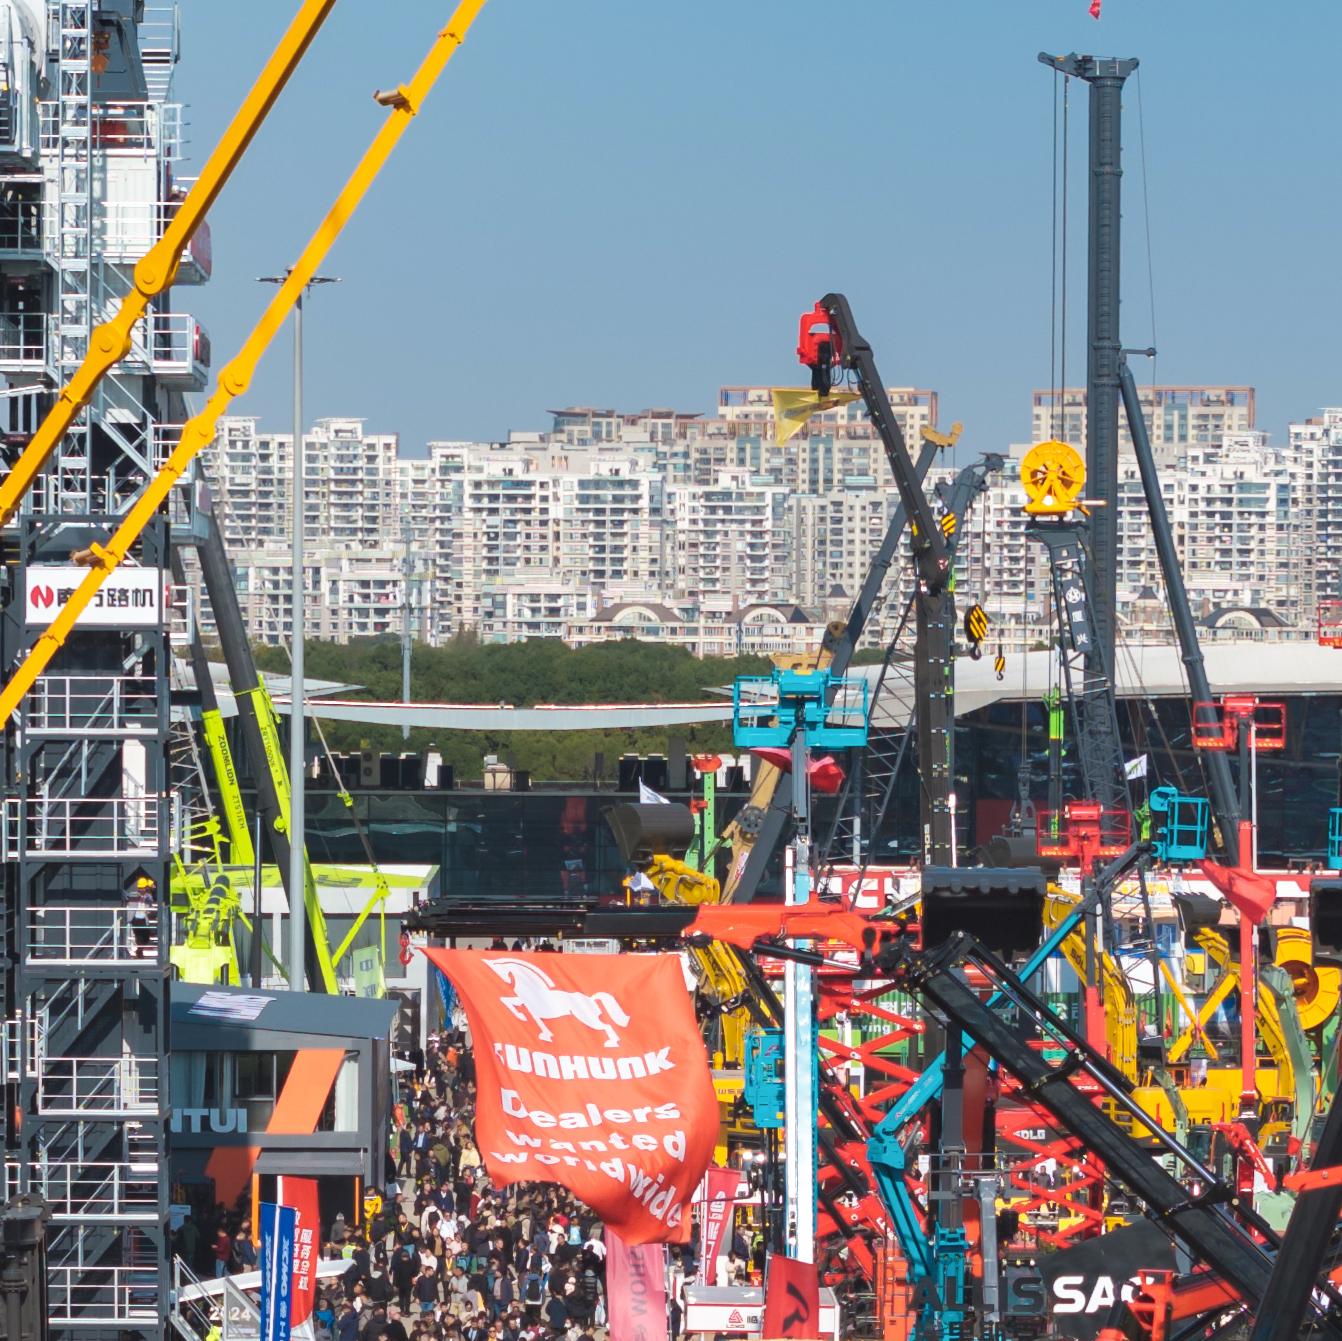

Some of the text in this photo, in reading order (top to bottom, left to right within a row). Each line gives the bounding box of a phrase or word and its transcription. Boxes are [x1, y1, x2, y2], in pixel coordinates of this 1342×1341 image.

[219, 733, 235, 786] ZOOMLION
[500, 1087, 680, 1131] Dealers
[505, 1129, 686, 1163] wanted
